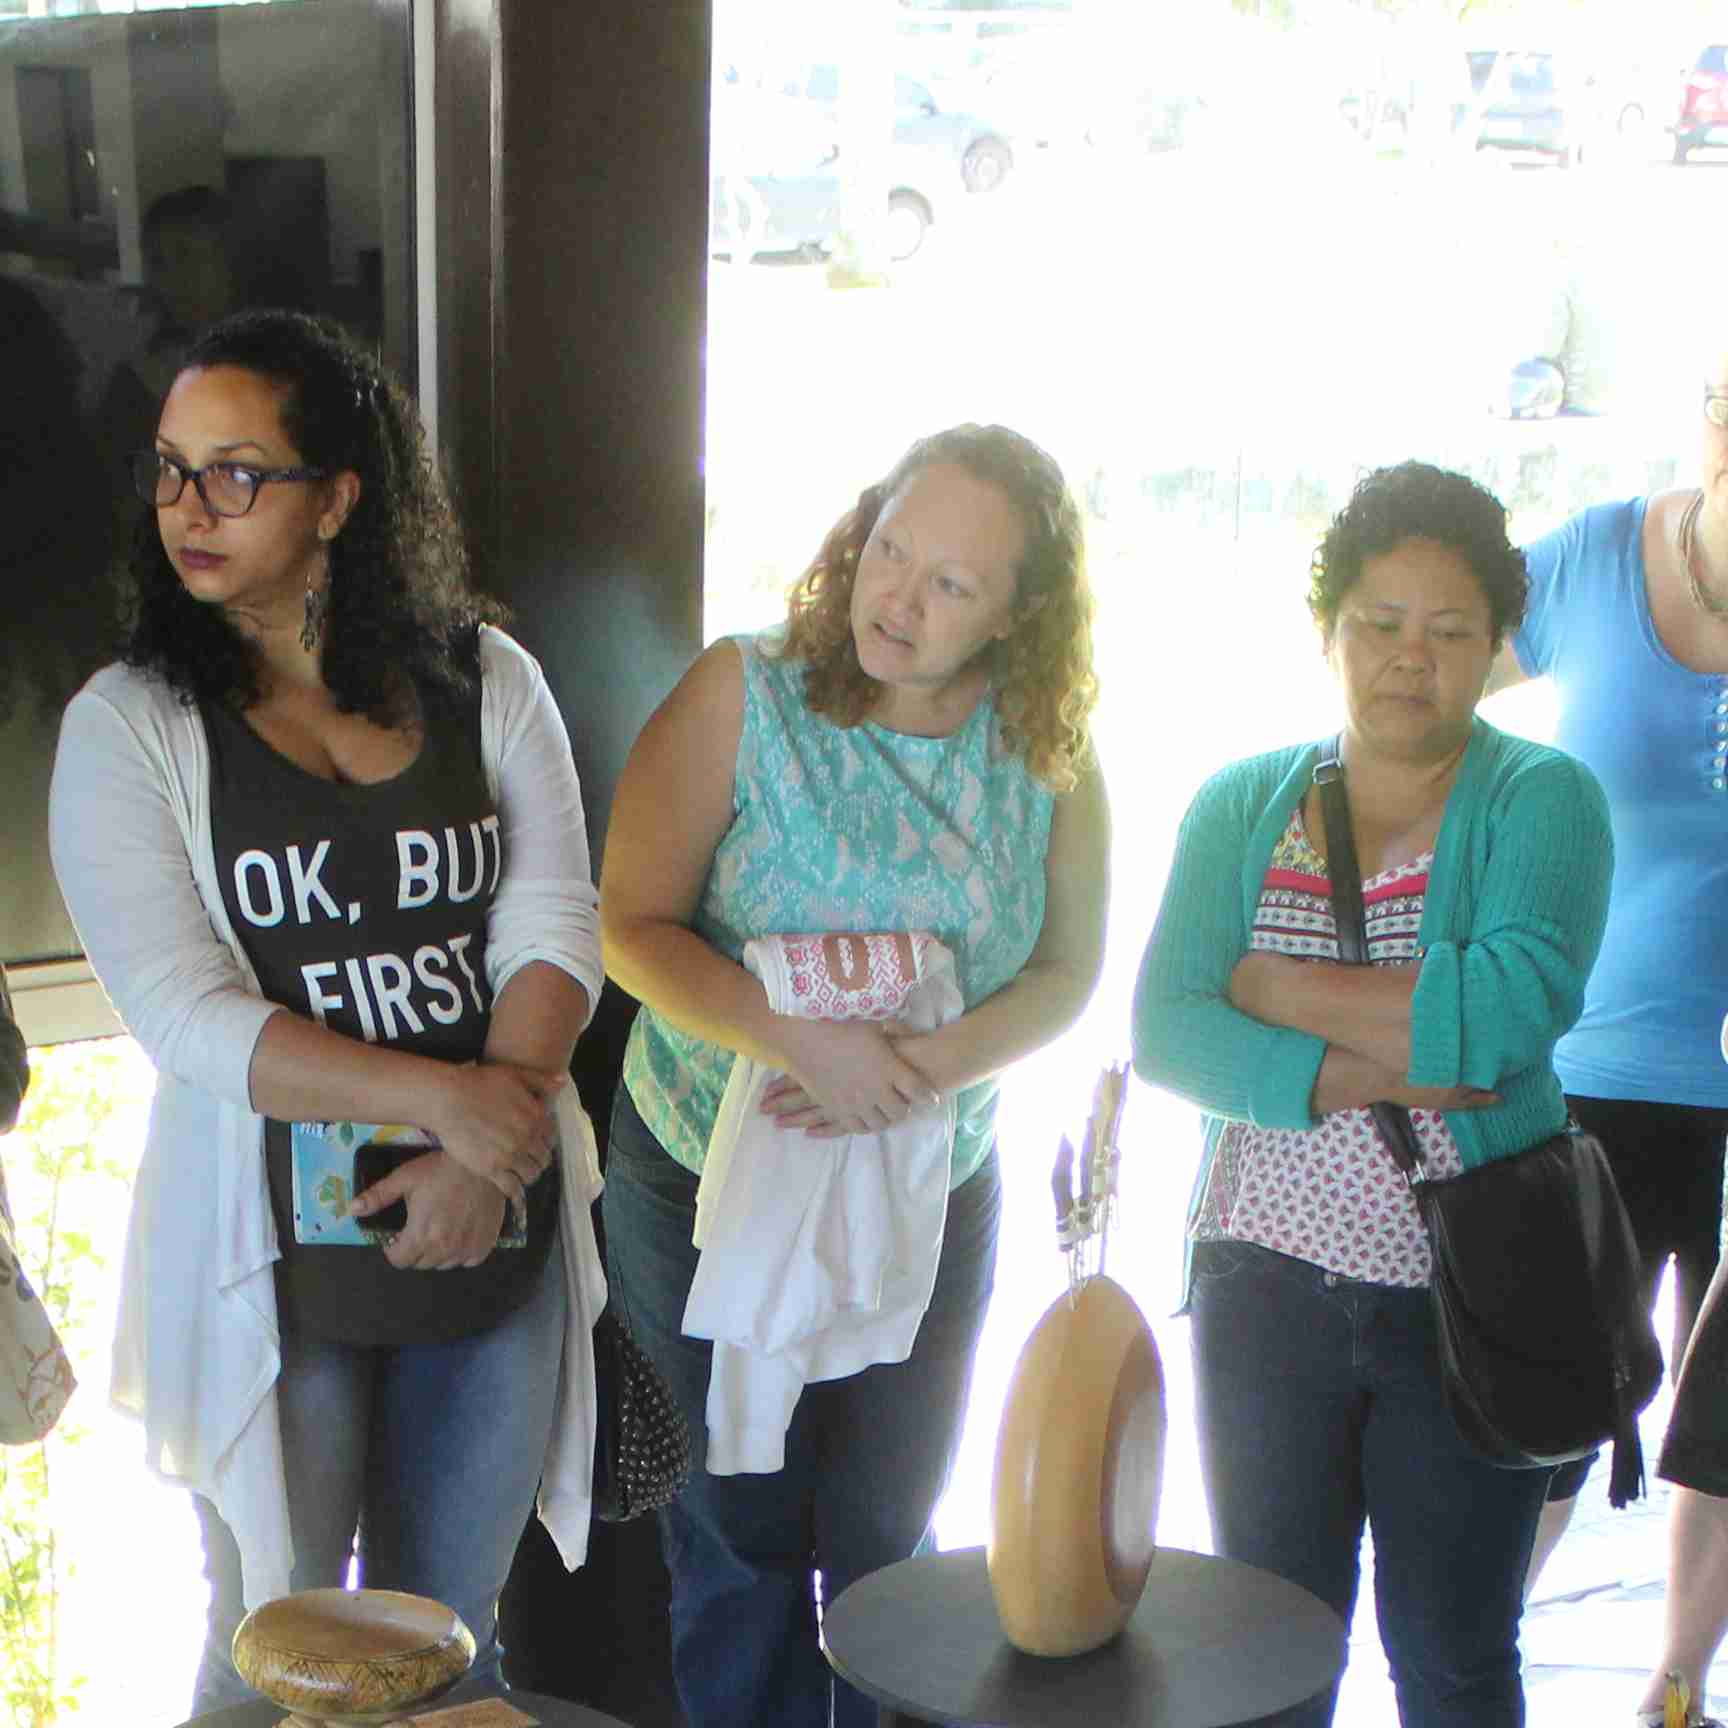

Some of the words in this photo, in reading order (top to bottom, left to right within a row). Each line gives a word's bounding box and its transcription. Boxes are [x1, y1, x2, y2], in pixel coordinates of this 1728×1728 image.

[233, 839, 362, 929] OK,
[394, 815, 501, 910] BUT
[300, 933, 484, 1043] FIRST
